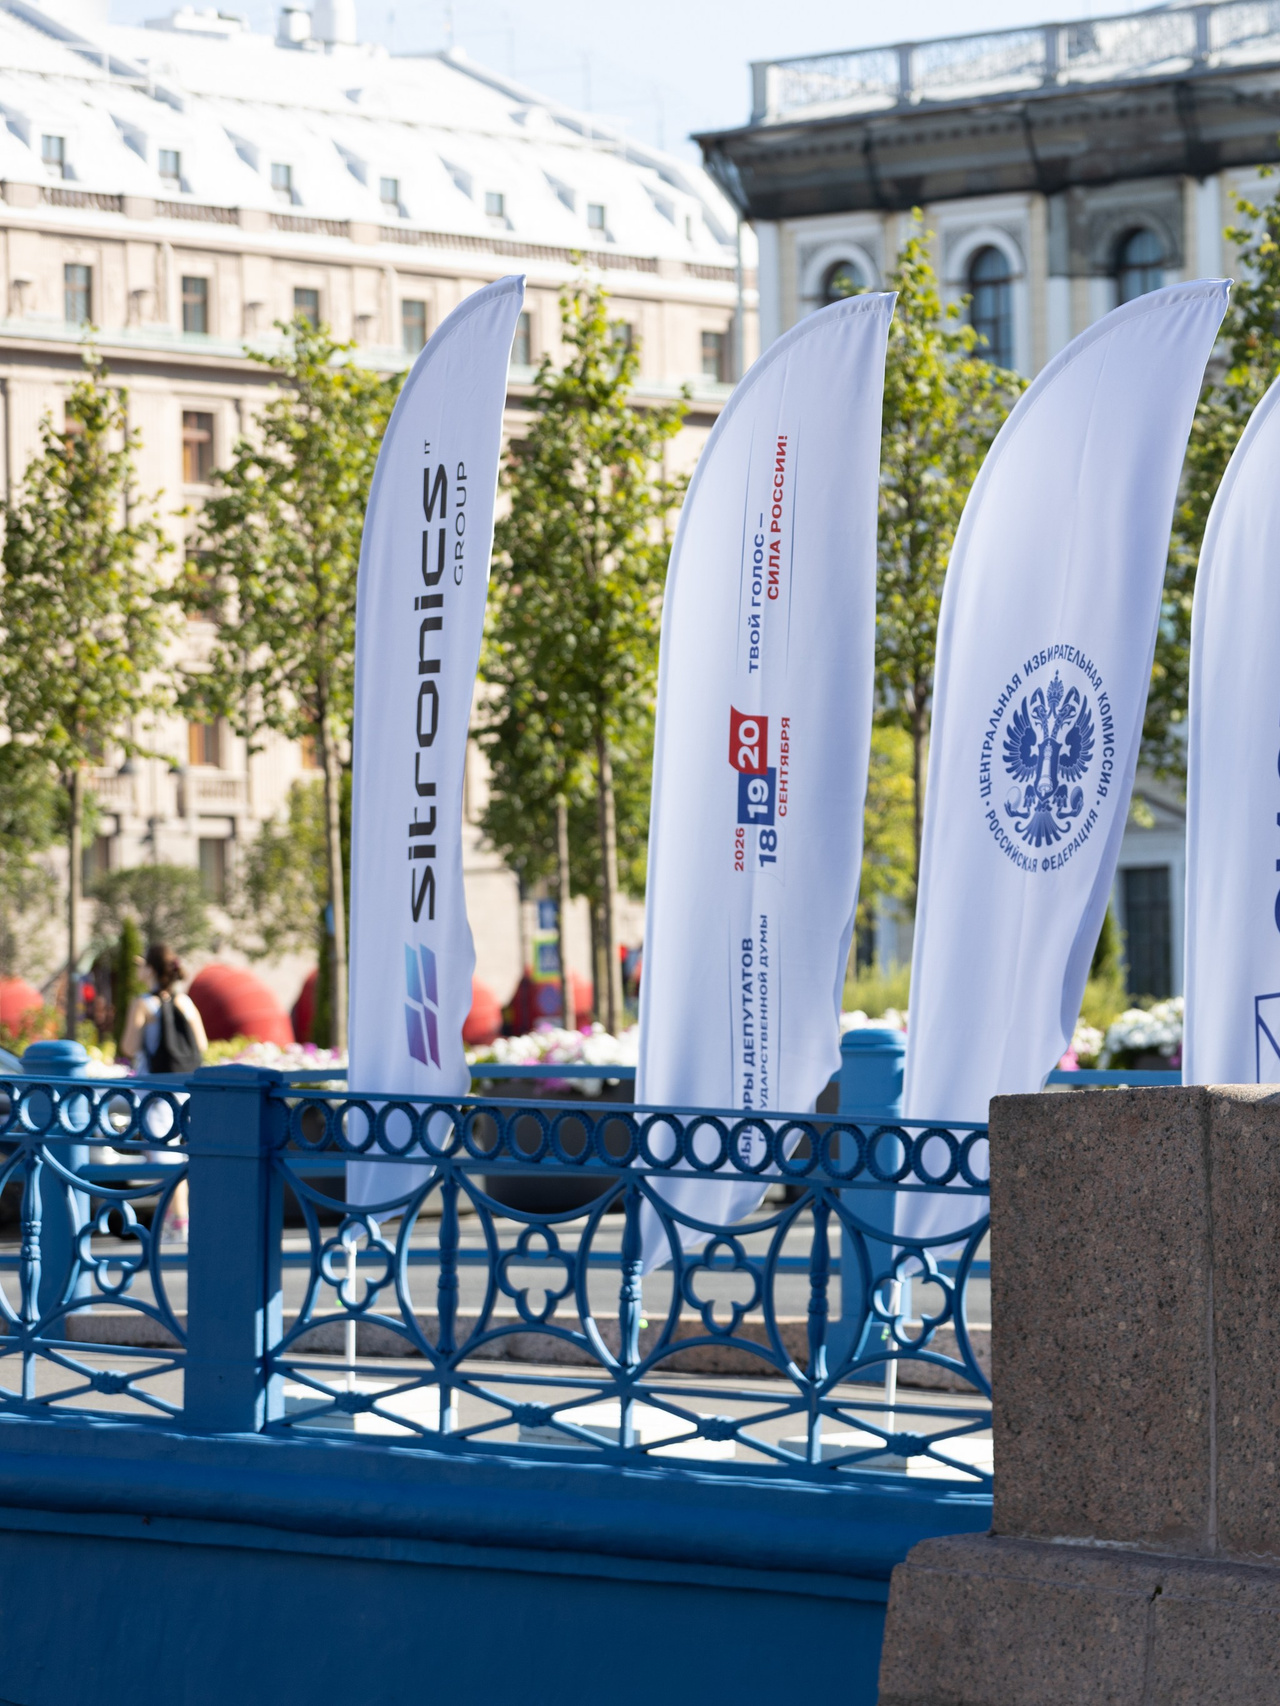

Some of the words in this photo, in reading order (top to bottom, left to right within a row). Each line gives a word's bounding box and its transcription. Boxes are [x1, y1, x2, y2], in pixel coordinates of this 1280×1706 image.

[424, 439, 431, 455] IT
[770, 435, 788, 533] РОССИИ!
[453, 461, 468, 586] GROUP
[751, 533, 765, 608] ГОЛОС
[767, 539, 781, 601] СИЛА
[748, 613, 762, 674] ТВОЙ
[737, 719, 760, 770] 20
[980, 673, 1023, 798] ЦЕНТРАЛЬНАЯ
[1023, 644, 1103, 692] ИЗБИРАТЕЛЬНАЯ
[1097, 691, 1115, 798] КОМИССИЯ
[747, 777, 770, 819] 19
[778, 716, 791, 817] СЕНТЯБРЯ
[734, 827, 745, 872] 2026
[758, 828, 778, 868] 18
[985, 809, 1038, 873] РОССИЙСКАЯ
[1041, 808, 1099, 872] ФЕДЕРАЦИЯ
[759, 914, 769, 968] ДУМЫ
[741, 937, 756, 1067] ДЕПУТАТОВ
[757, 971, 769, 1142] ГУДАРСТВЕННОЙ
